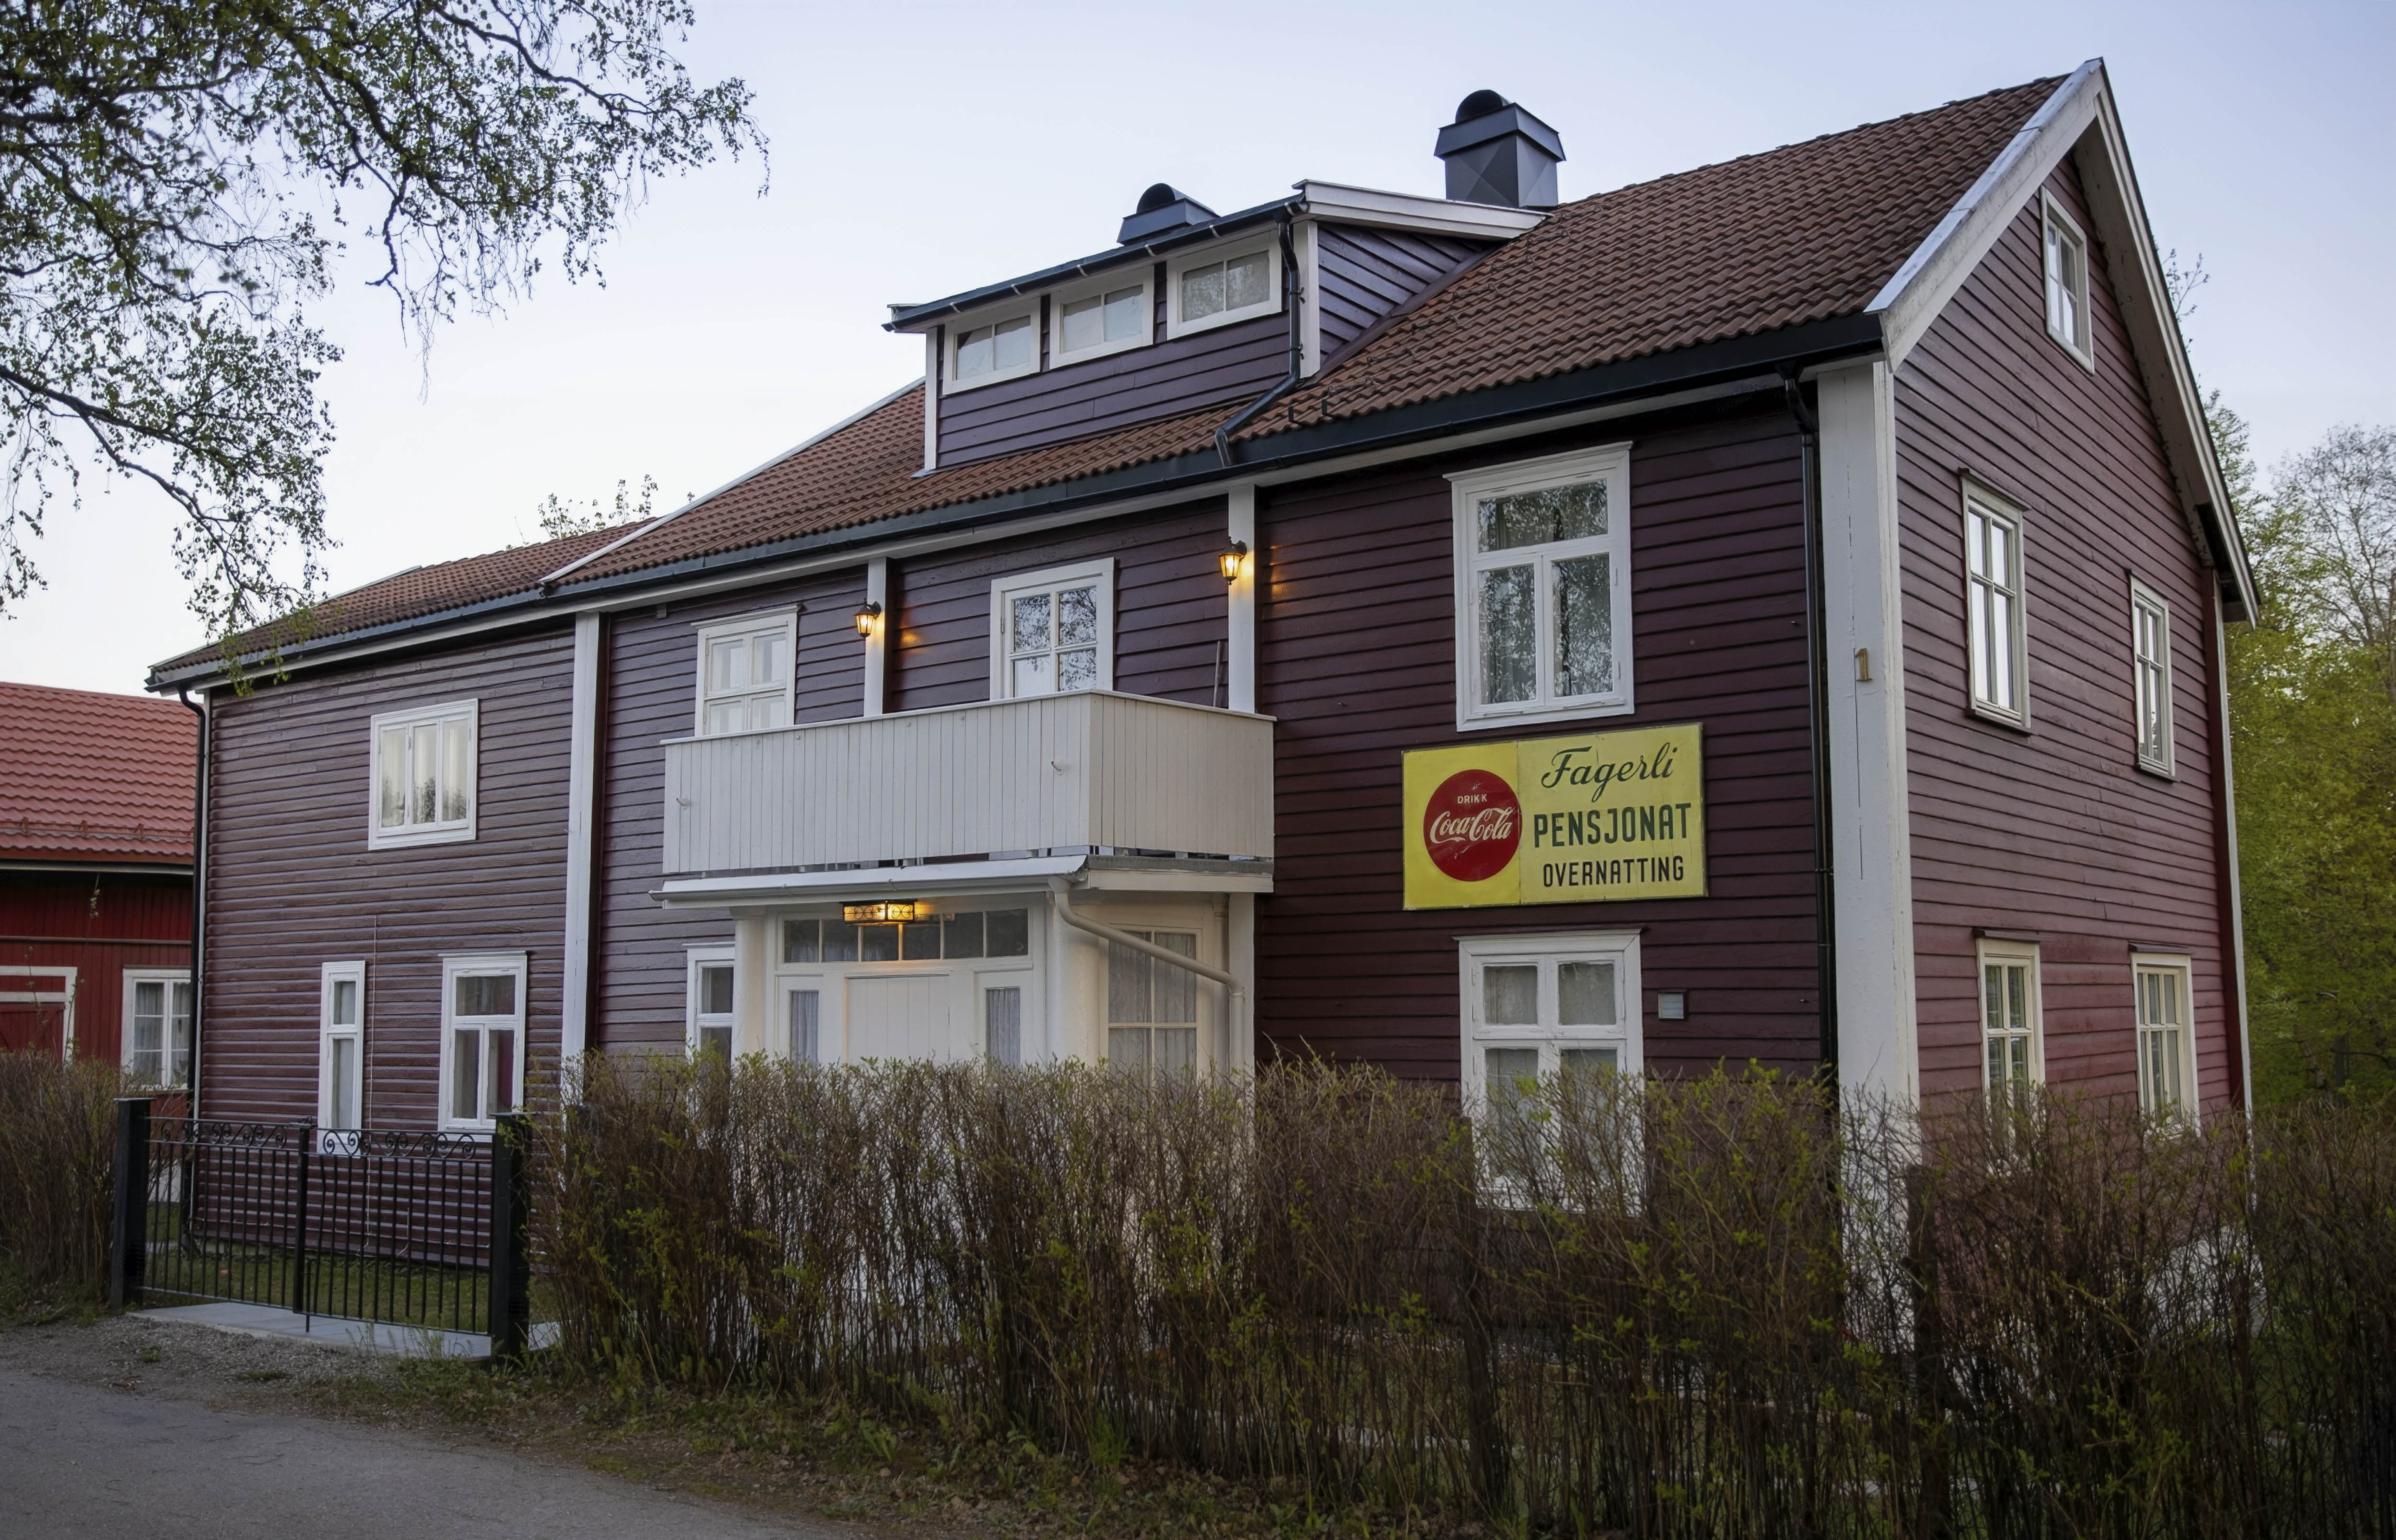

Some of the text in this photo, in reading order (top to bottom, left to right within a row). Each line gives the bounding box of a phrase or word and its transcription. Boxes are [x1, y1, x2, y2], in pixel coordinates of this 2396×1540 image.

[1855, 648, 1872, 682] 1
[1541, 742, 1677, 803] Fagerli
[1457, 794, 1487, 804] DRIKK
[1430, 807, 1515, 844] Coca-Cola
[1534, 803, 1691, 848] PENSJONAT
[1543, 856, 1684, 887] OVERNATTING
